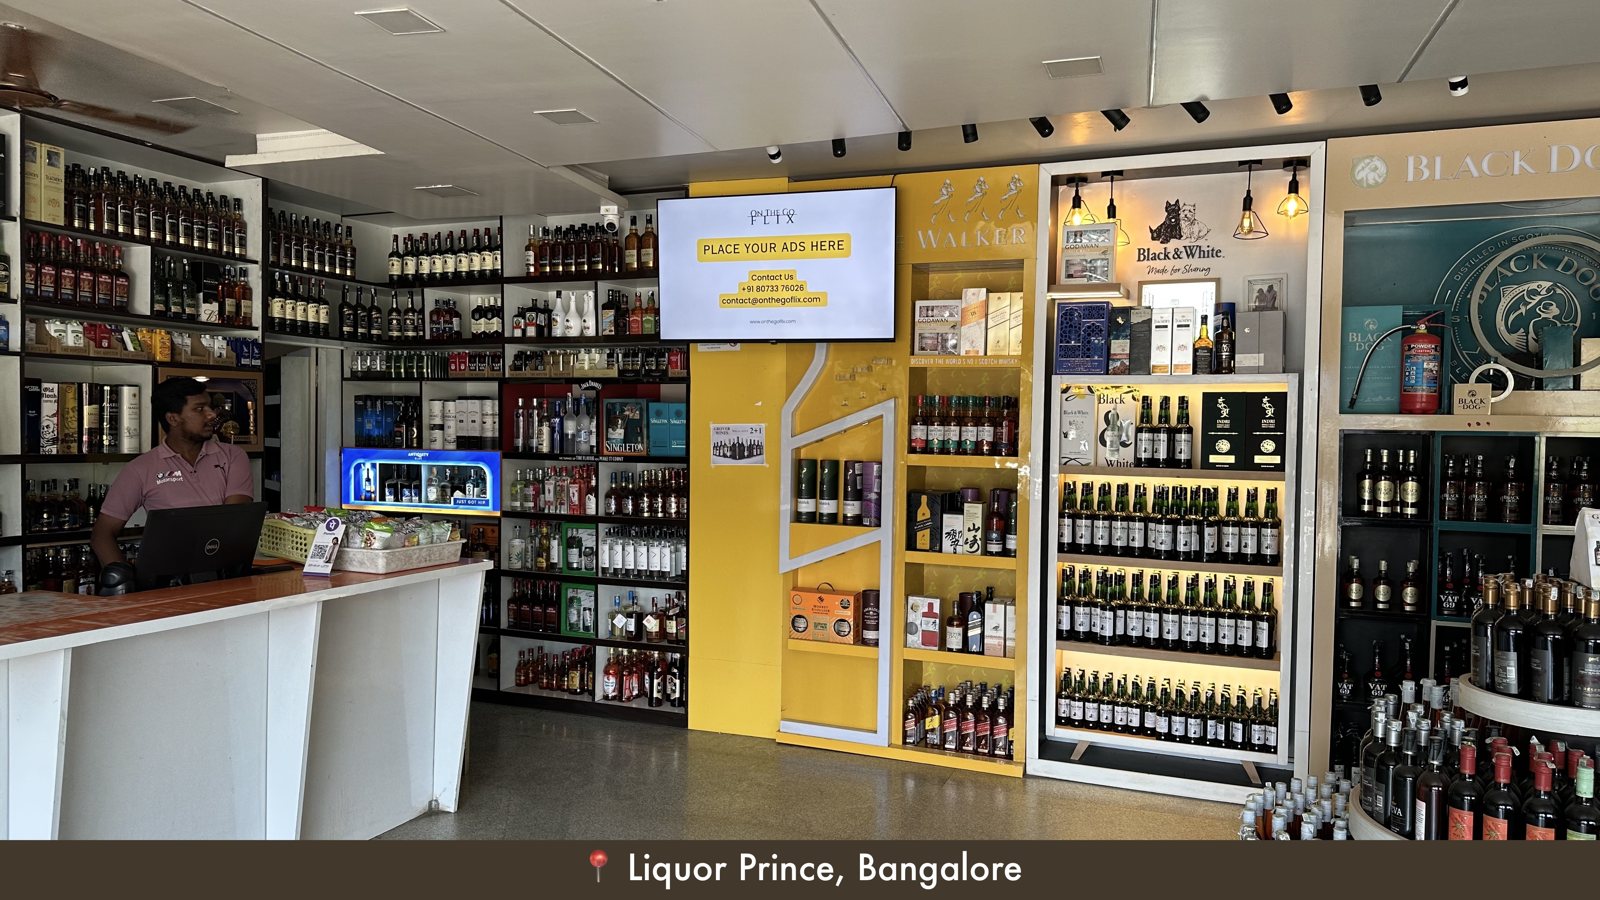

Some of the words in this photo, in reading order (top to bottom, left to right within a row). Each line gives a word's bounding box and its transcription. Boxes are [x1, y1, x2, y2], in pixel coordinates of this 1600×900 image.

[1406, 149, 1537, 183] BLACK
[765, 208, 780, 217] THE
[750, 214, 795, 226] FLIX
[917, 226, 1026, 249] WALKER
[703, 243, 740, 255] PLACE
[744, 242, 777, 254] YOUR
[781, 241, 806, 252] ADS
[810, 239, 845, 252] HERE
[1453, 245, 1497, 282] DISTILLED
[1497, 239, 1509, 248] IN
[1146, 264, 1169, 275] Made
[1169, 264, 1181, 276] for
[1181, 263, 1211, 276] Sharing
[751, 273, 782, 282] Contact
[783, 273, 794, 281] Us
[741, 285, 755, 293] +91
[755, 285, 779, 293] 80733
[780, 284, 805, 292] 76026
[721, 295, 821, 306] contact@onthegoflix.com
[1098, 393, 1126, 405] Black
[1458, 397, 1486, 405] BLACK
[606, 440, 645, 454] SINGLETON
[1104, 457, 1135, 468] White
[1439, 594, 1460, 603] VAT
[1337, 682, 1354, 690] VAT
[1368, 682, 1388, 691] VAT
[1371, 689, 1384, 697] 69
